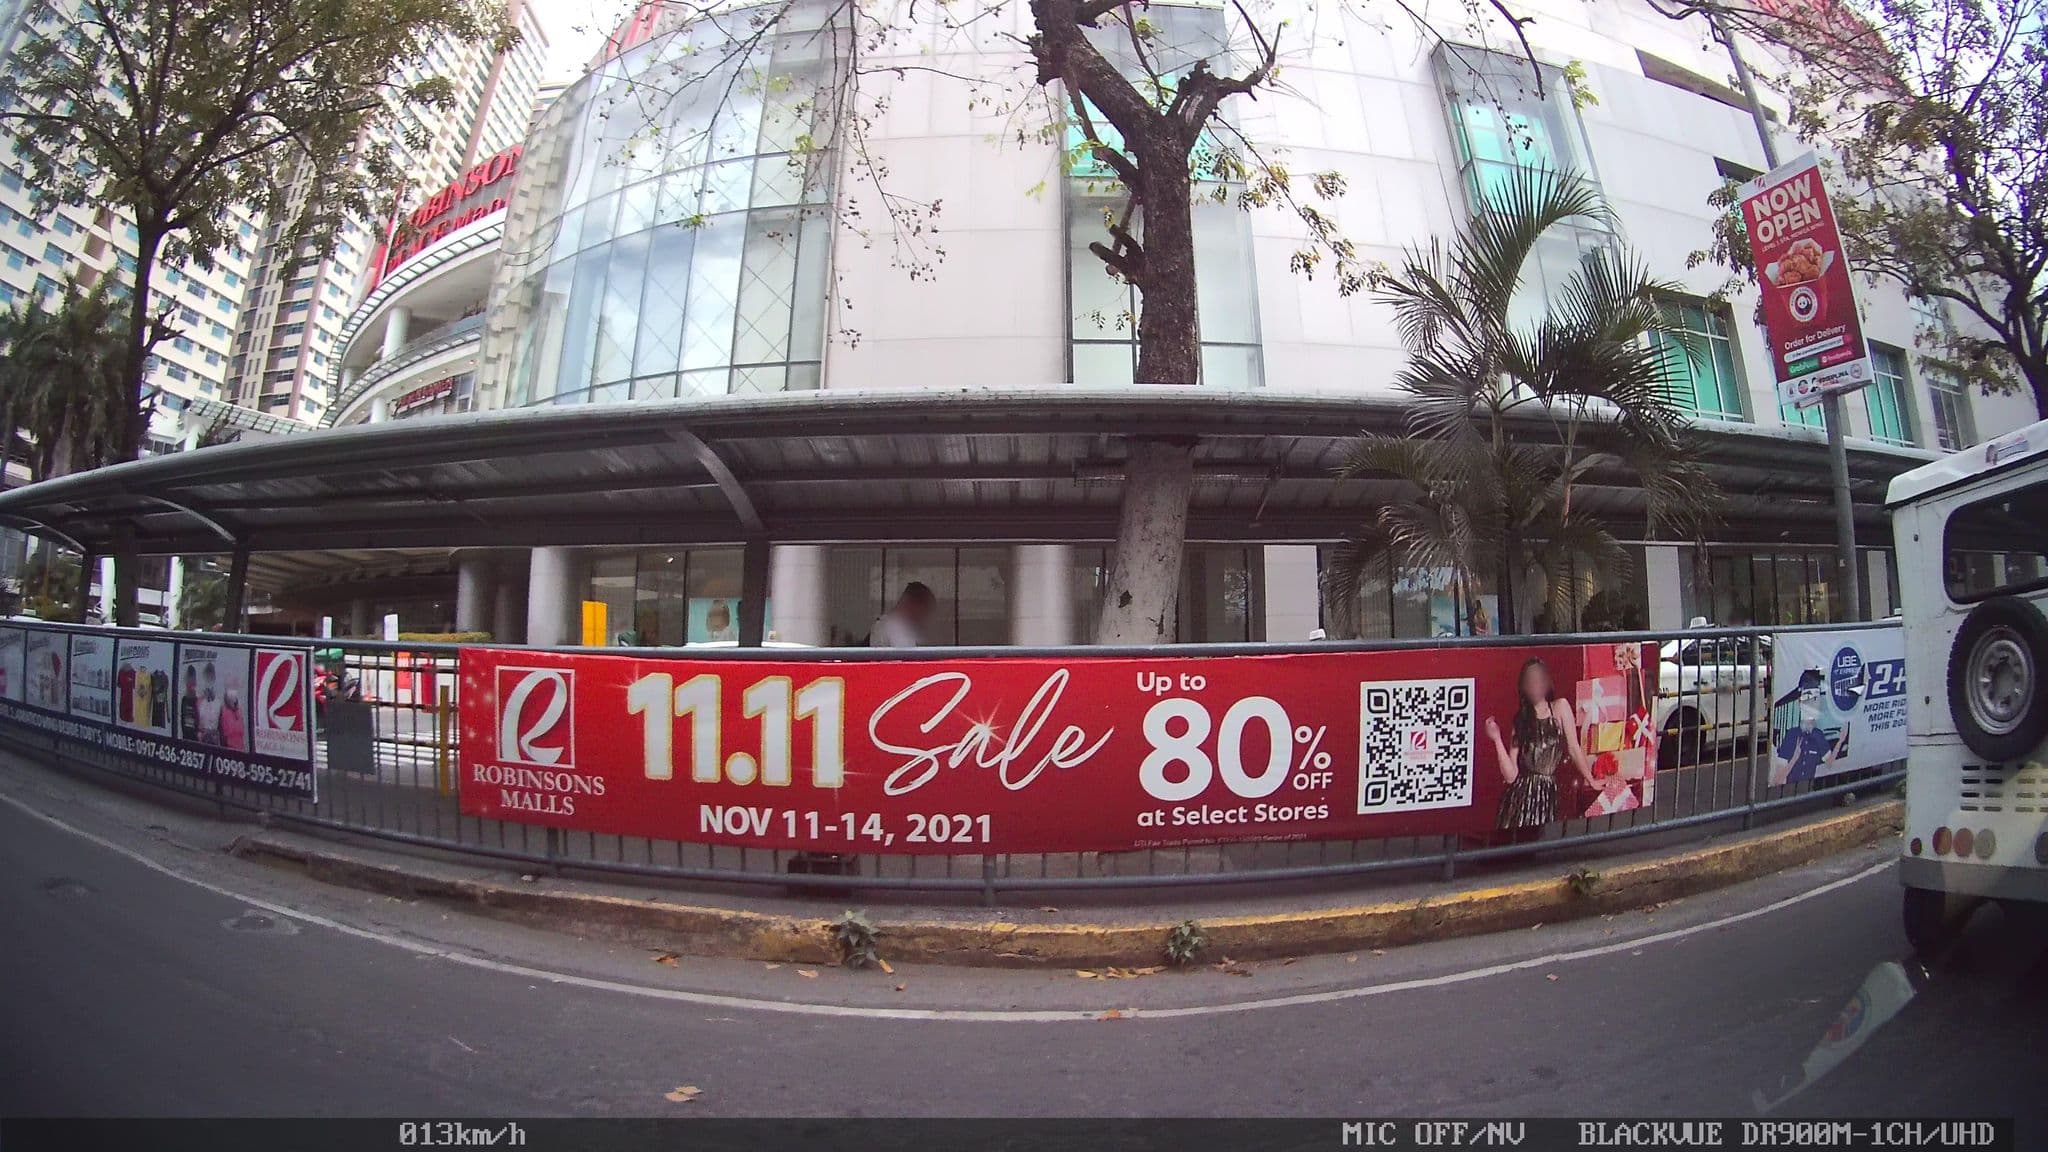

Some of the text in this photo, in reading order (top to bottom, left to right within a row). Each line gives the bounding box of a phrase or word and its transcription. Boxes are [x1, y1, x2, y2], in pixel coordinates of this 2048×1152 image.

[1752, 174, 1811, 222] NOW
[1757, 198, 1821, 243] OPEN
[1784, 338, 1804, 350] Order
[1805, 333, 1816, 343] for
[1817, 325, 1846, 339] Delivery
[1837, 655, 1857, 668] UBE
[1136, 671, 1206, 696] Up to
[1863, 701, 1890, 713] MORE
[1867, 710, 1895, 723] MORE
[628, 668, 1114, 796] 11.11 Sale
[1870, 722, 1890, 732] THIS
[136, 738, 205, 770] 0917-636-2857
[216, 758, 312, 792] 0998-595-2741
[473, 763, 606, 796] ROBINSONS
[1293, 772, 1333, 790] OFF
[501, 789, 575, 815] MALLS
[700, 804, 991, 846] NOV 11-14, 2021
[1137, 804, 1329, 827] at Select Stores
